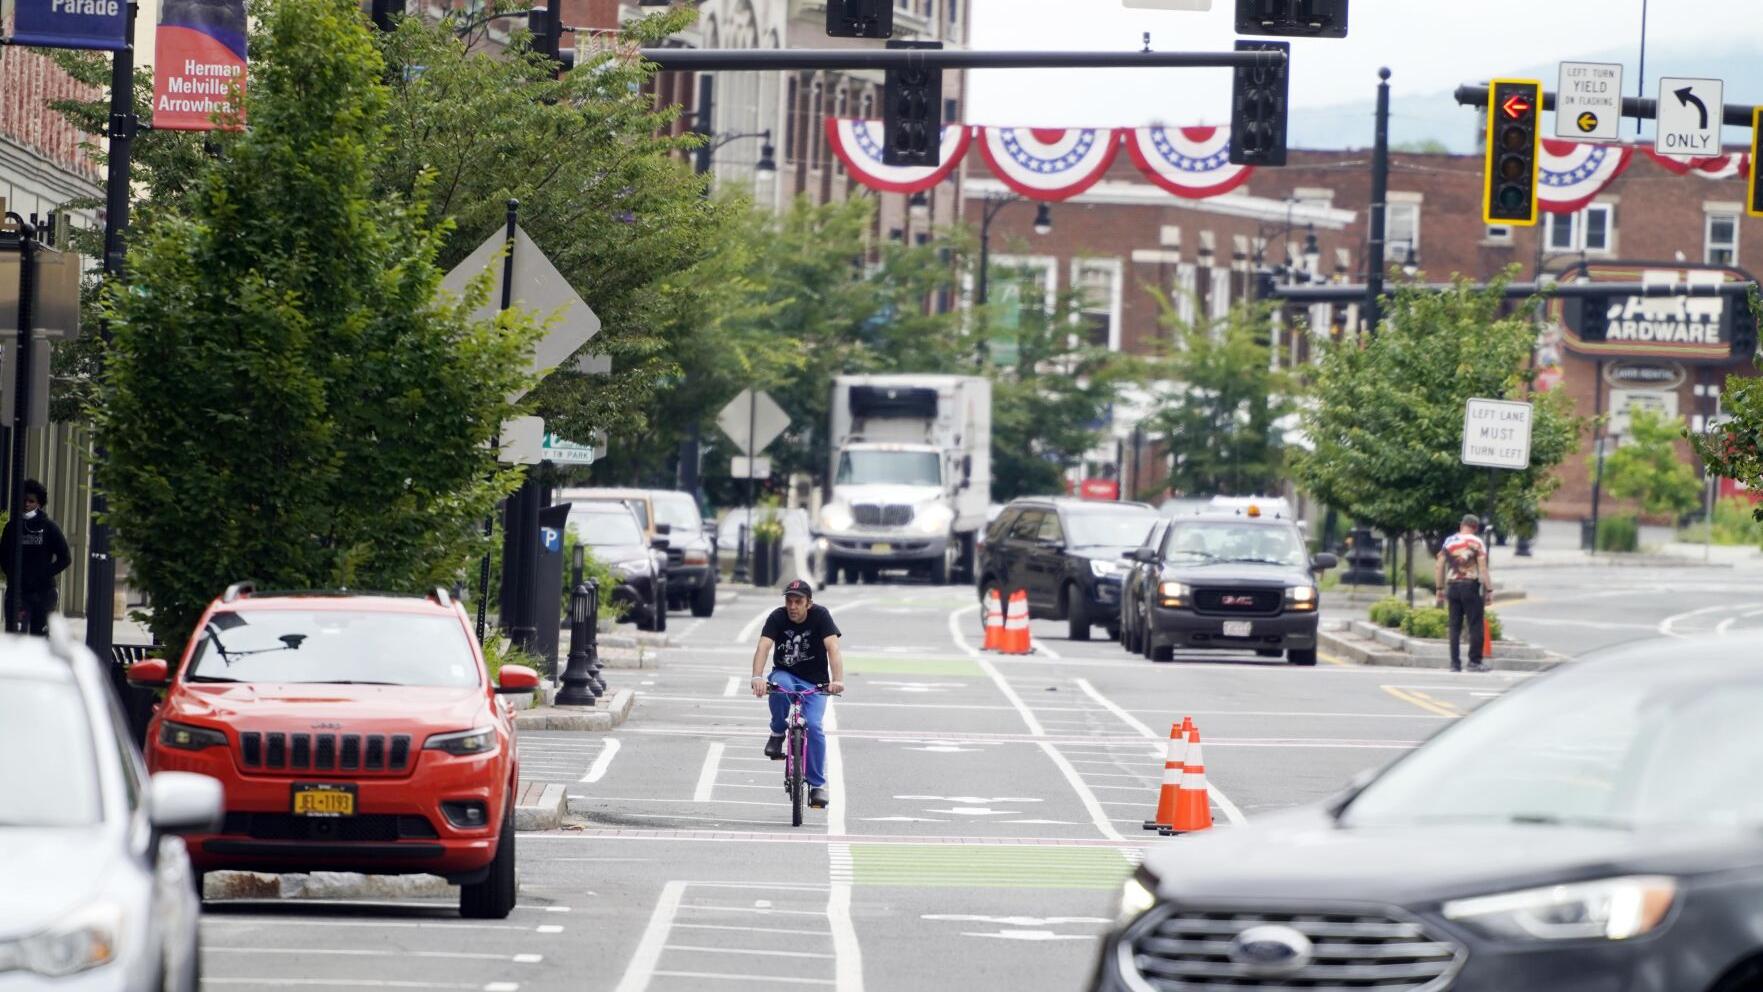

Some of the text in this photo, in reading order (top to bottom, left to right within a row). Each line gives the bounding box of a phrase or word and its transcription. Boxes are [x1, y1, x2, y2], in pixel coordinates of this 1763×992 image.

[52, 0, 118, 16] Parade
[185, 59, 241, 75] Herman
[1567, 68, 1614, 78] LEFT TURN
[168, 77, 241, 94] Melville's
[1573, 81, 1607, 93] YIELD
[1578, 97, 1612, 106] FLASHING
[1666, 133, 1710, 148] ONLY
[1606, 320, 1720, 343] ARDWARE
[1471, 408, 1525, 422] LEFT LANE
[1480, 427, 1515, 440] MUST
[567, 451, 588, 459] PARK
[1470, 445, 1522, 459] TURN LEFT
[1222, 595, 1253, 605] GMC
